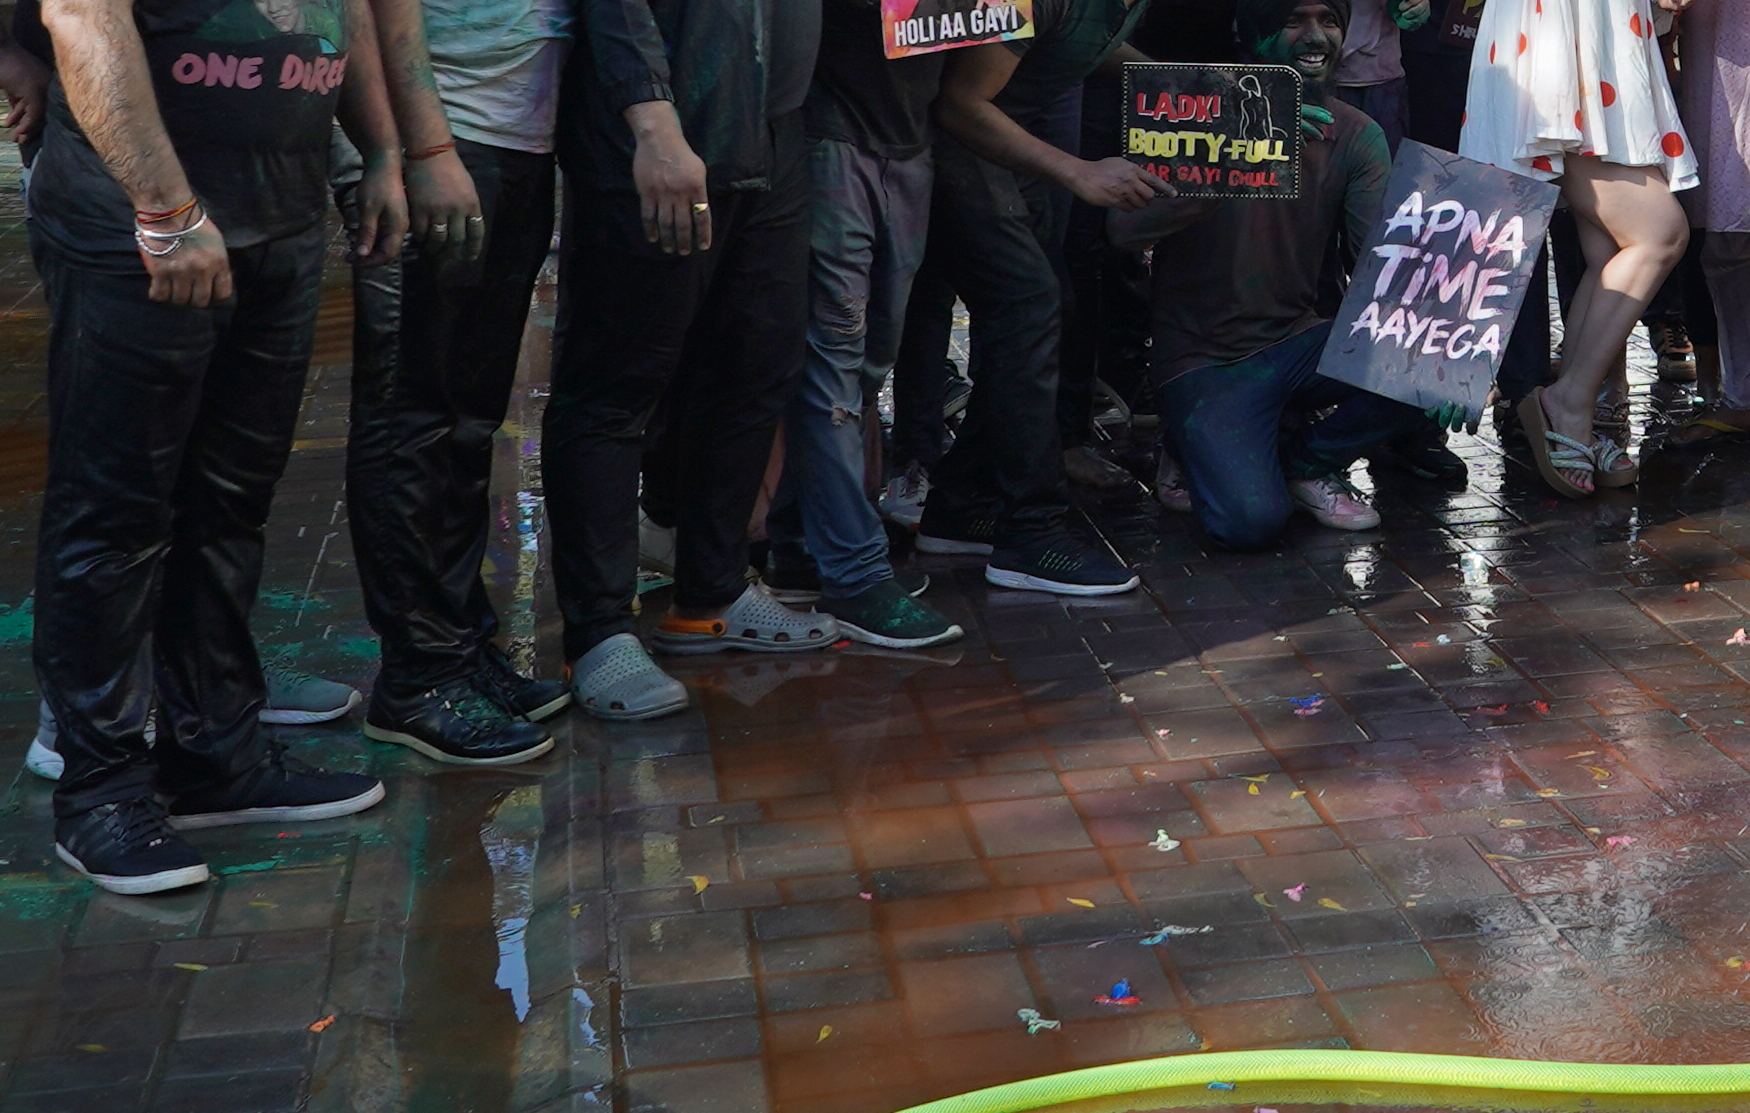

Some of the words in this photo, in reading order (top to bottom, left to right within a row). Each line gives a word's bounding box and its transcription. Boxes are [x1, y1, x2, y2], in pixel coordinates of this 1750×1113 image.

[894, 16, 935, 47] HOLI
[939, 11, 967, 40] AA
[971, 5, 1019, 35] GAYI
[171, 51, 265, 89] ONE
[278, 52, 349, 96] DIRE
[1136, 92, 1222, 123] LADKI
[1128, 127, 1290, 163] BOOTY-FULL
[1139, 162, 1171, 181] AR
[1176, 165, 1222, 186] GAYI
[1228, 170, 1279, 187] CHULL
[1384, 191, 1528, 268] APNA
[1349, 300, 1501, 363] AAYEGA
